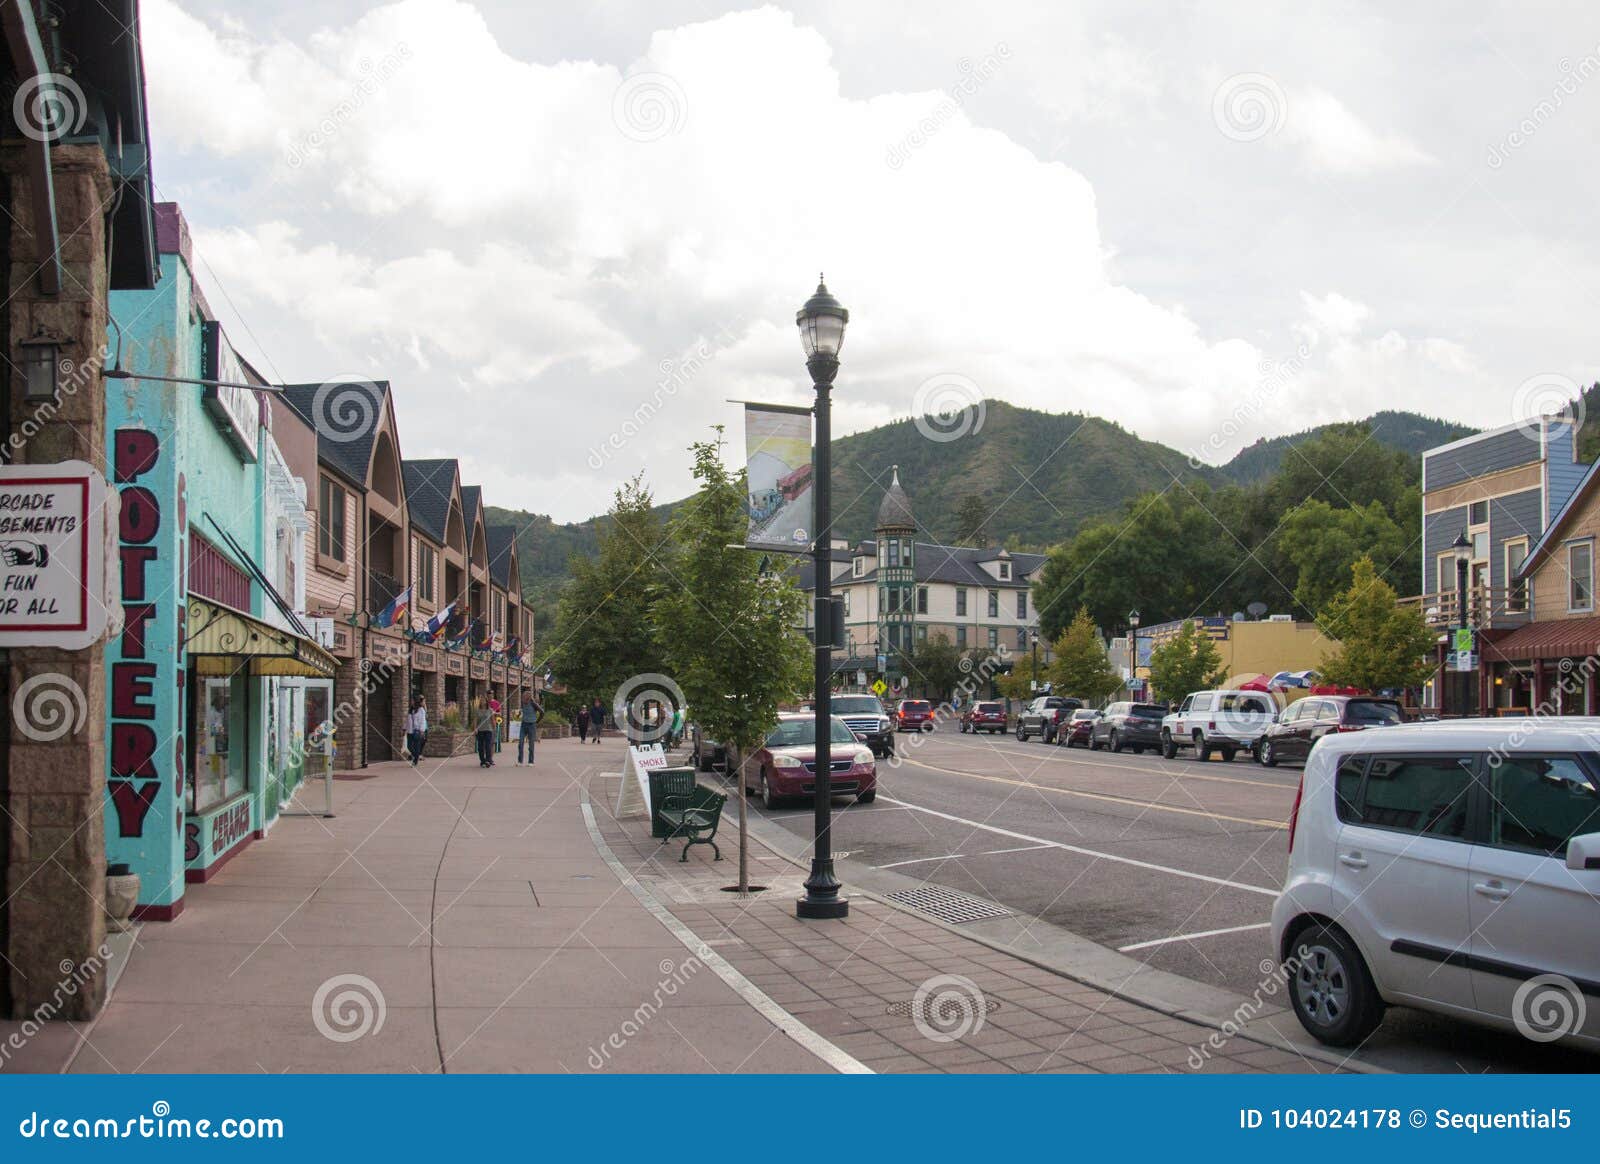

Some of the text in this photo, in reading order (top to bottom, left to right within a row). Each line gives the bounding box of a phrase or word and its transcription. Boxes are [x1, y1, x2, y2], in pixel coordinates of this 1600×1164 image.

[0, 515, 76, 534] SEMENTS
[4, 575, 38, 592] FUN
[27, 598, 59, 615] ALL
[107, 428, 161, 838] POTTERY
[638, 757, 664, 768] SMOKE
